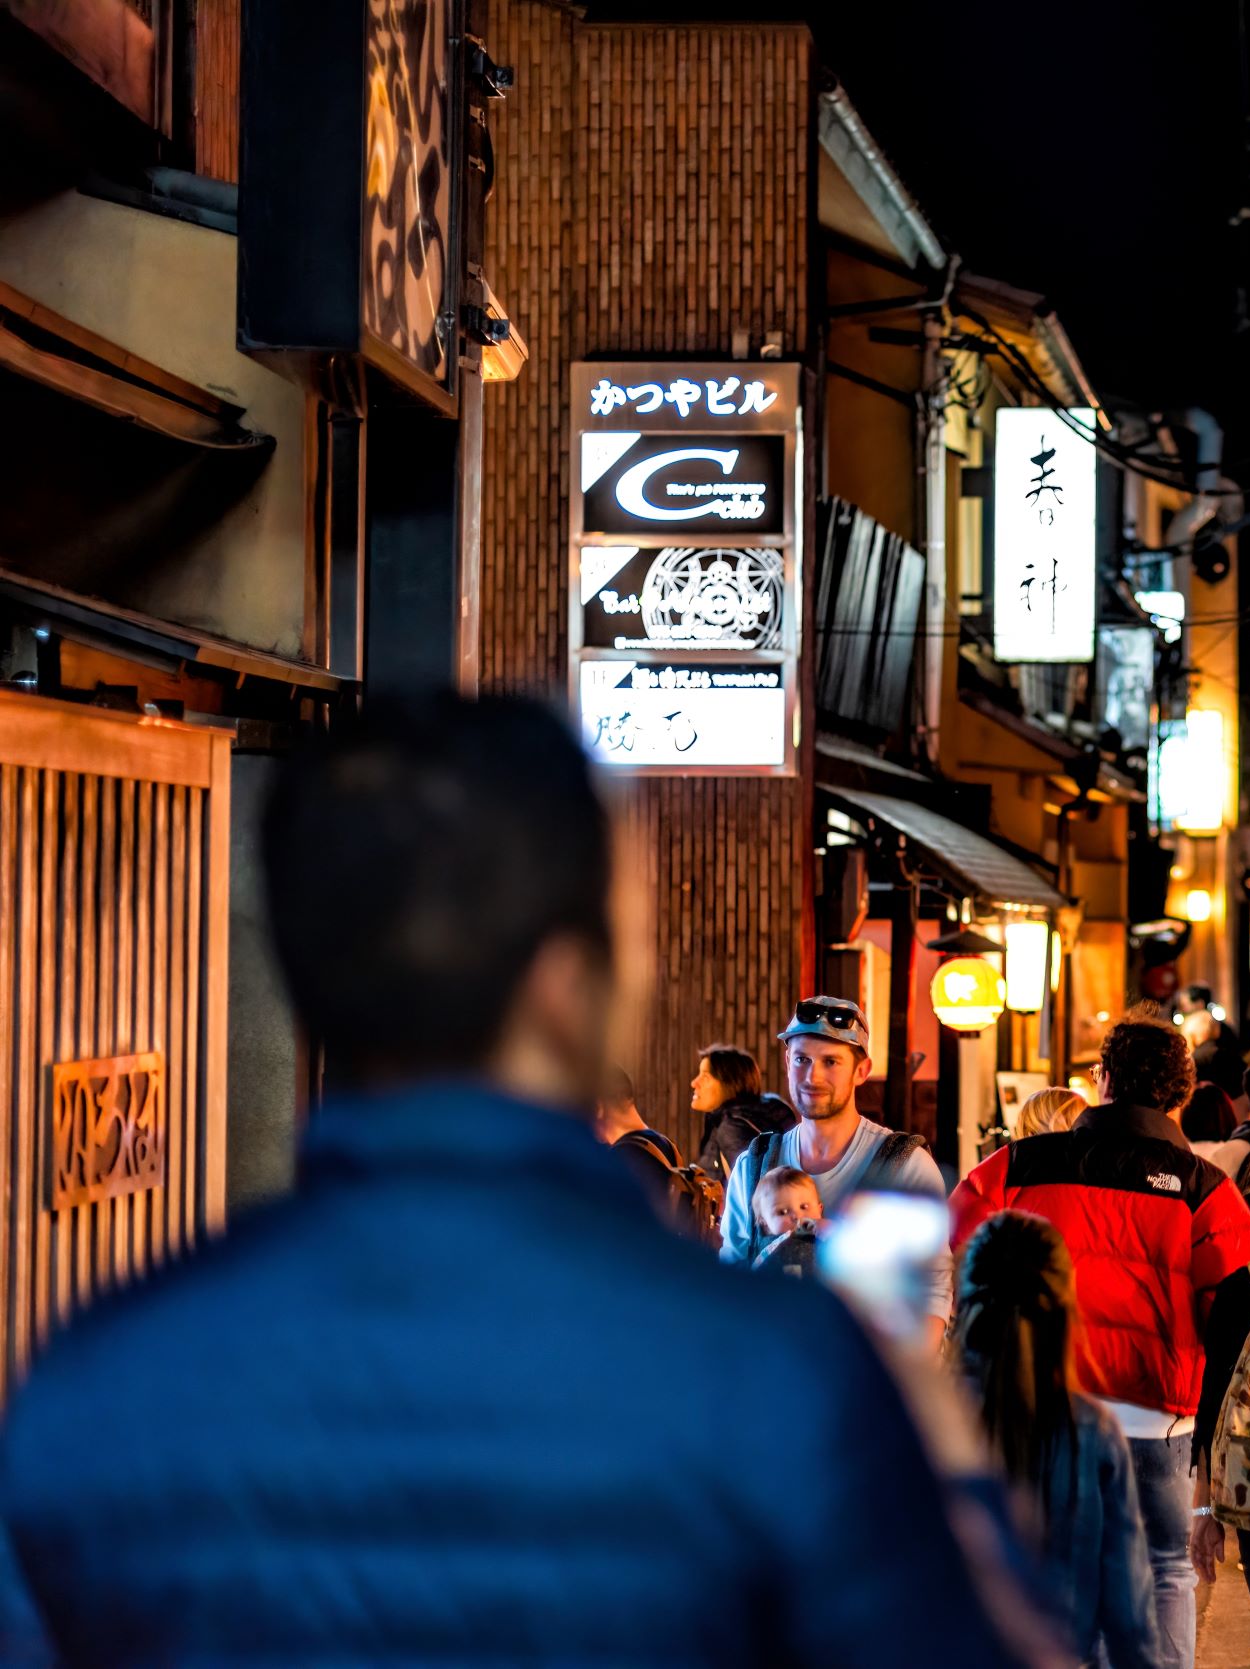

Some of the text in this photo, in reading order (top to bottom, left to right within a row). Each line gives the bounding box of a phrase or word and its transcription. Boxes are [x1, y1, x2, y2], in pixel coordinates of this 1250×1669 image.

[590, 376, 778, 418] かつやビル
[1147, 1174, 1171, 1186] NORTH
[1159, 1172, 1172, 1181] THE
[1153, 1181, 1171, 1190] FACE
